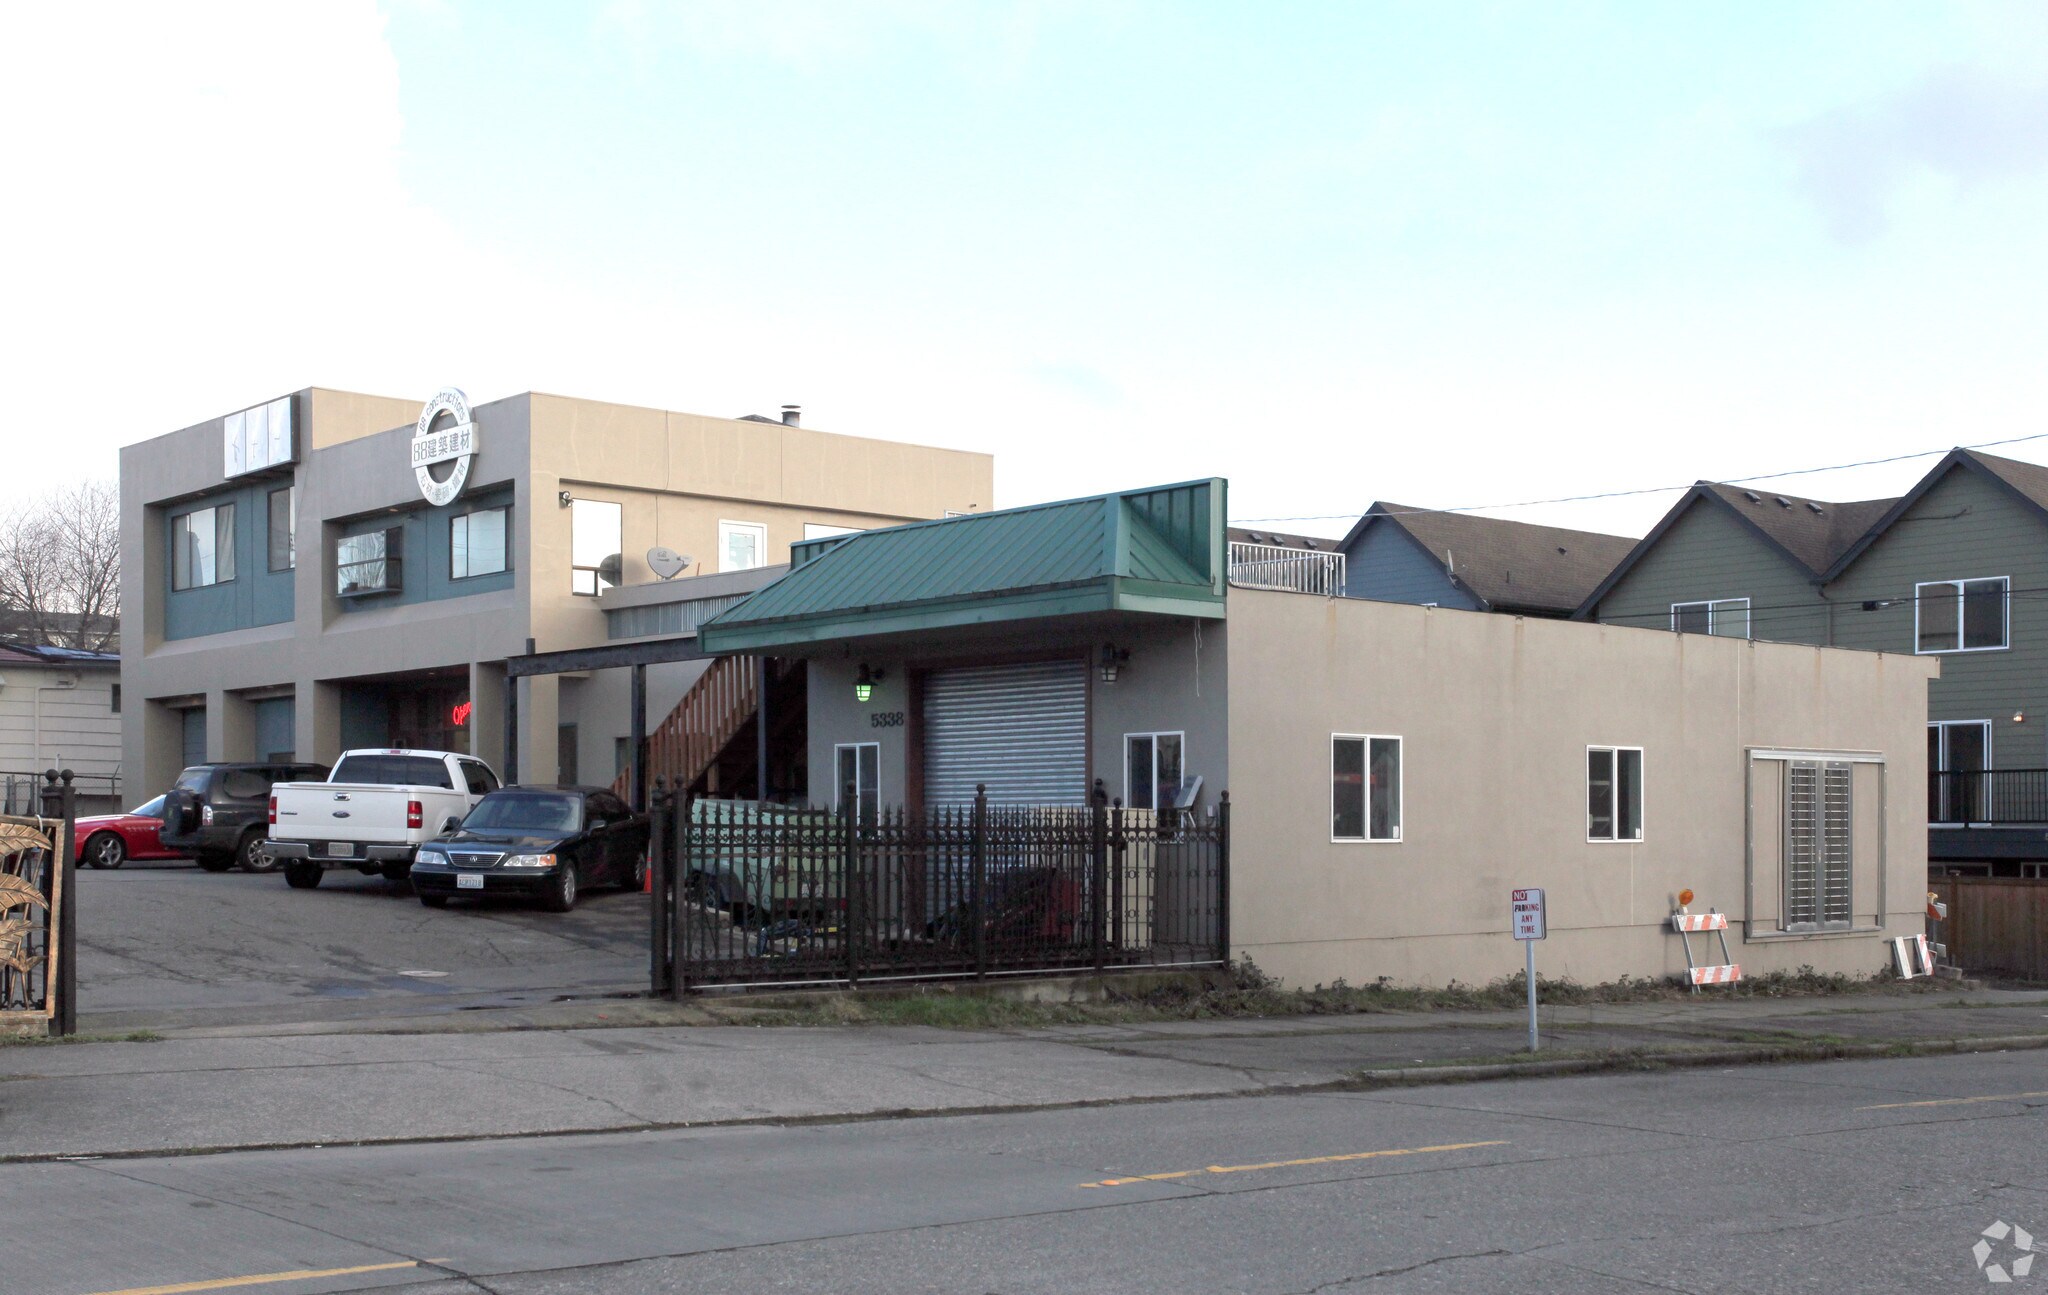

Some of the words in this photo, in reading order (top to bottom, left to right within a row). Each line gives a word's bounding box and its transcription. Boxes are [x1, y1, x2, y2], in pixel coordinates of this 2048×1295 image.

[871, 711, 905, 728] 5338
[1513, 891, 1526, 900] NO
[1514, 904, 1540, 912] PARKING
[1521, 915, 1533, 923] ANY
[1520, 925, 1535, 934] TIME
